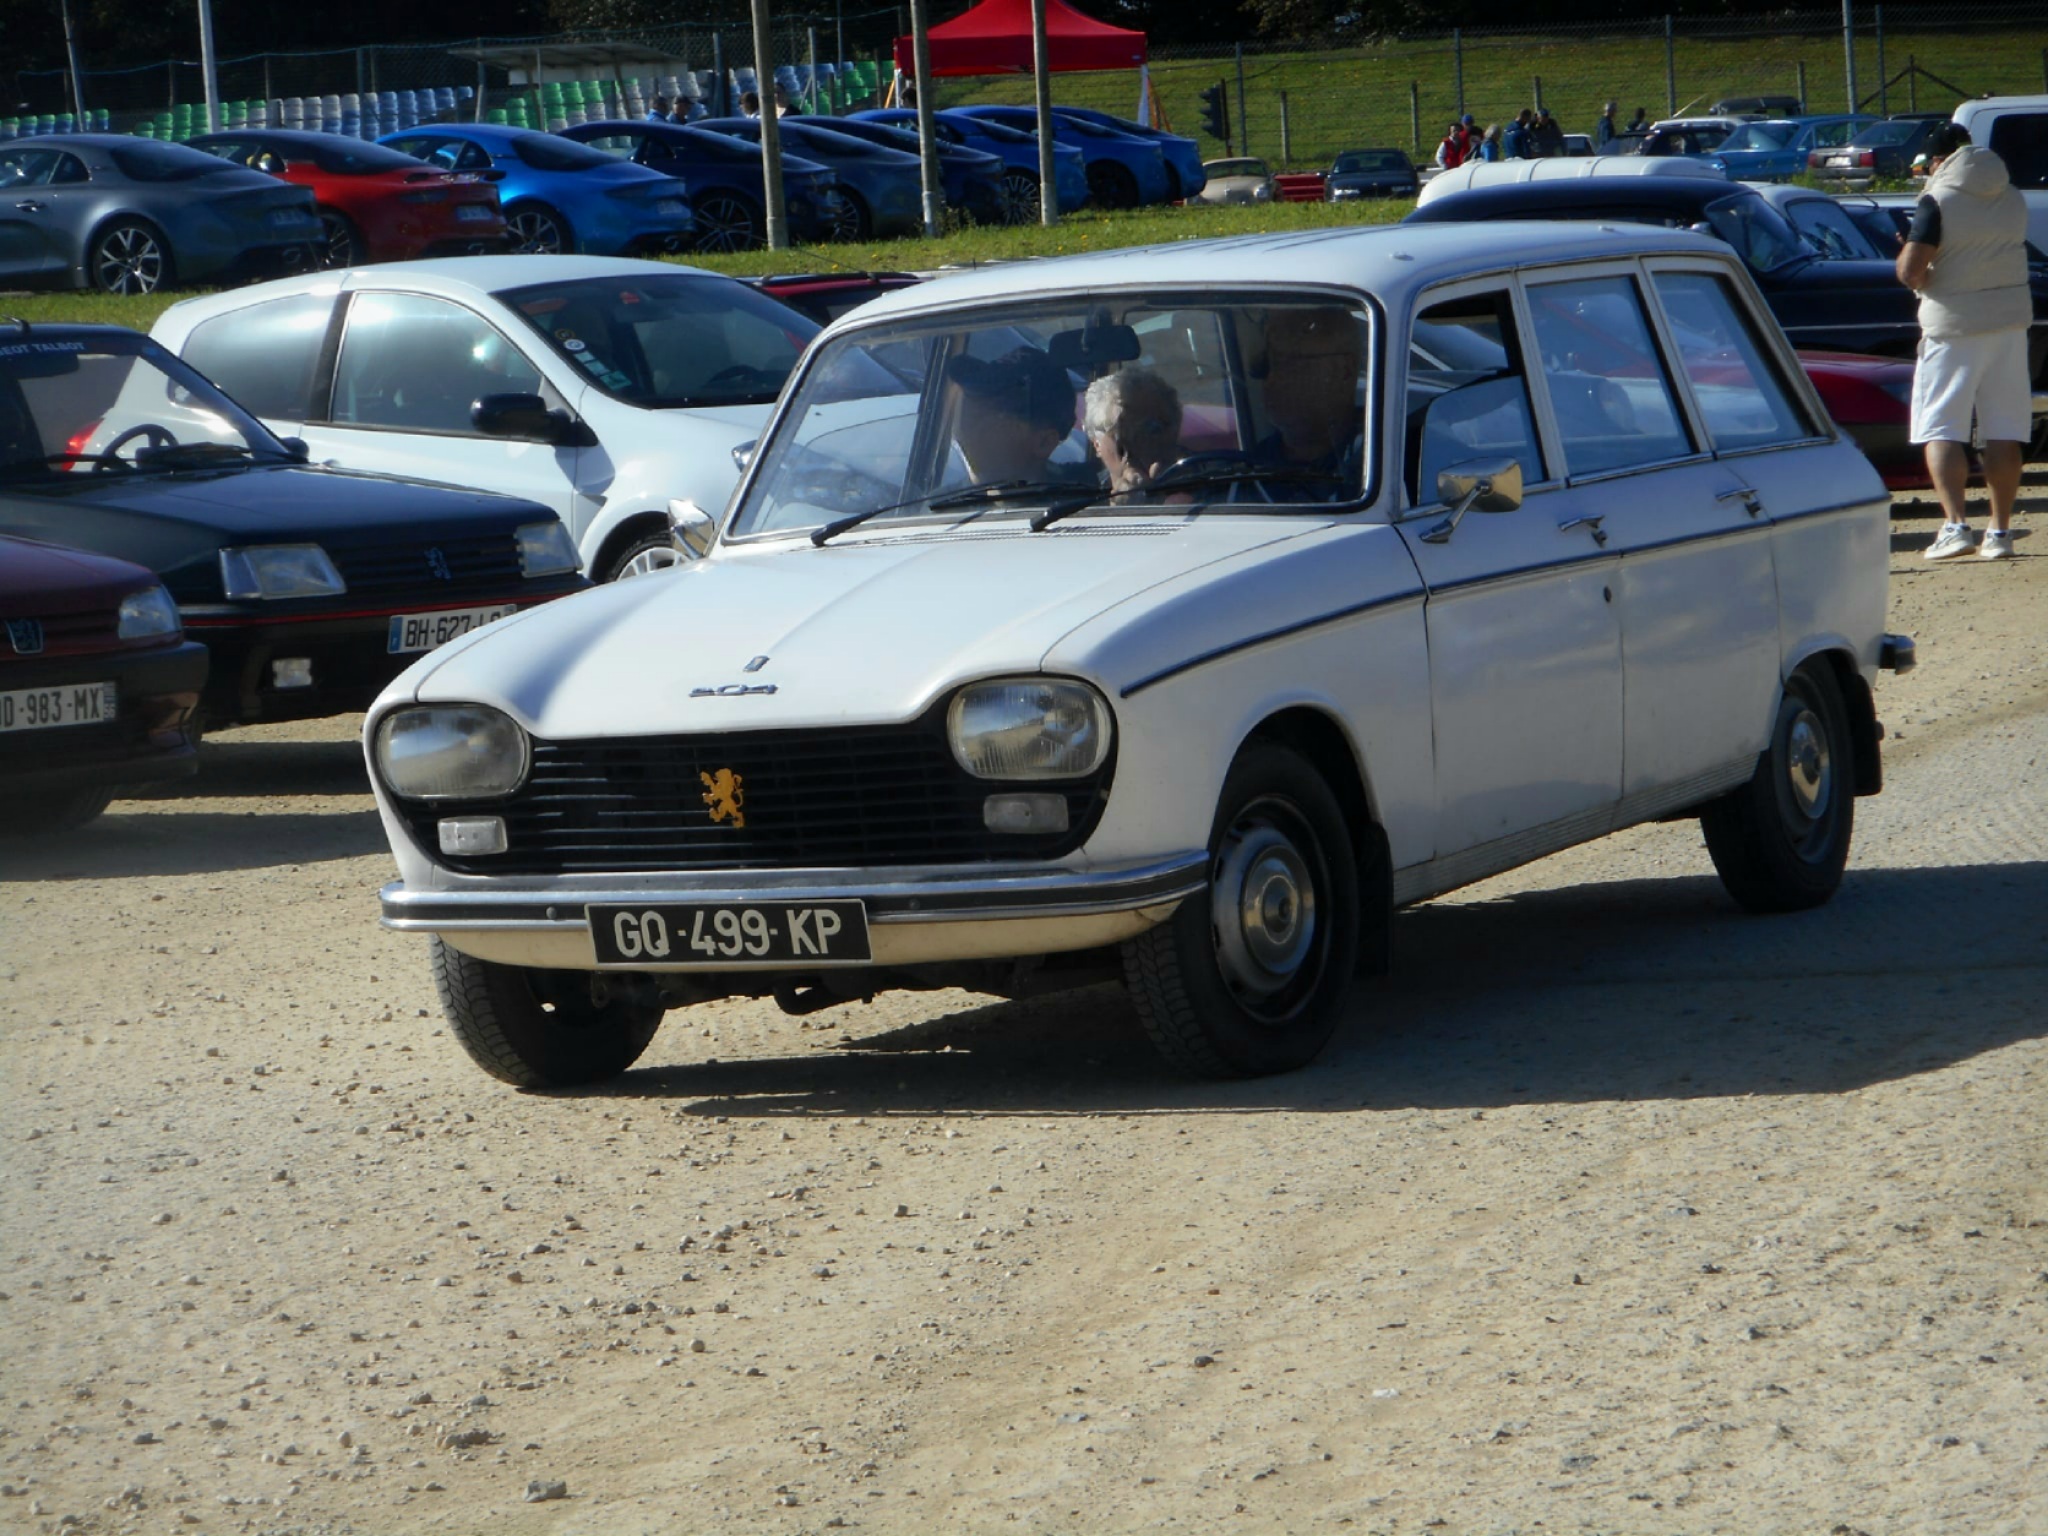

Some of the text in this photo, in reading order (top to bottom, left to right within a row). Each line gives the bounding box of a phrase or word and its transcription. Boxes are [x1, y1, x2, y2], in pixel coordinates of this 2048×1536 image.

[31, 342, 85, 353] TALBOT
[0, 686, 101, 729] D-983-MX
[613, 908, 842, 958] GQ-499-KP
